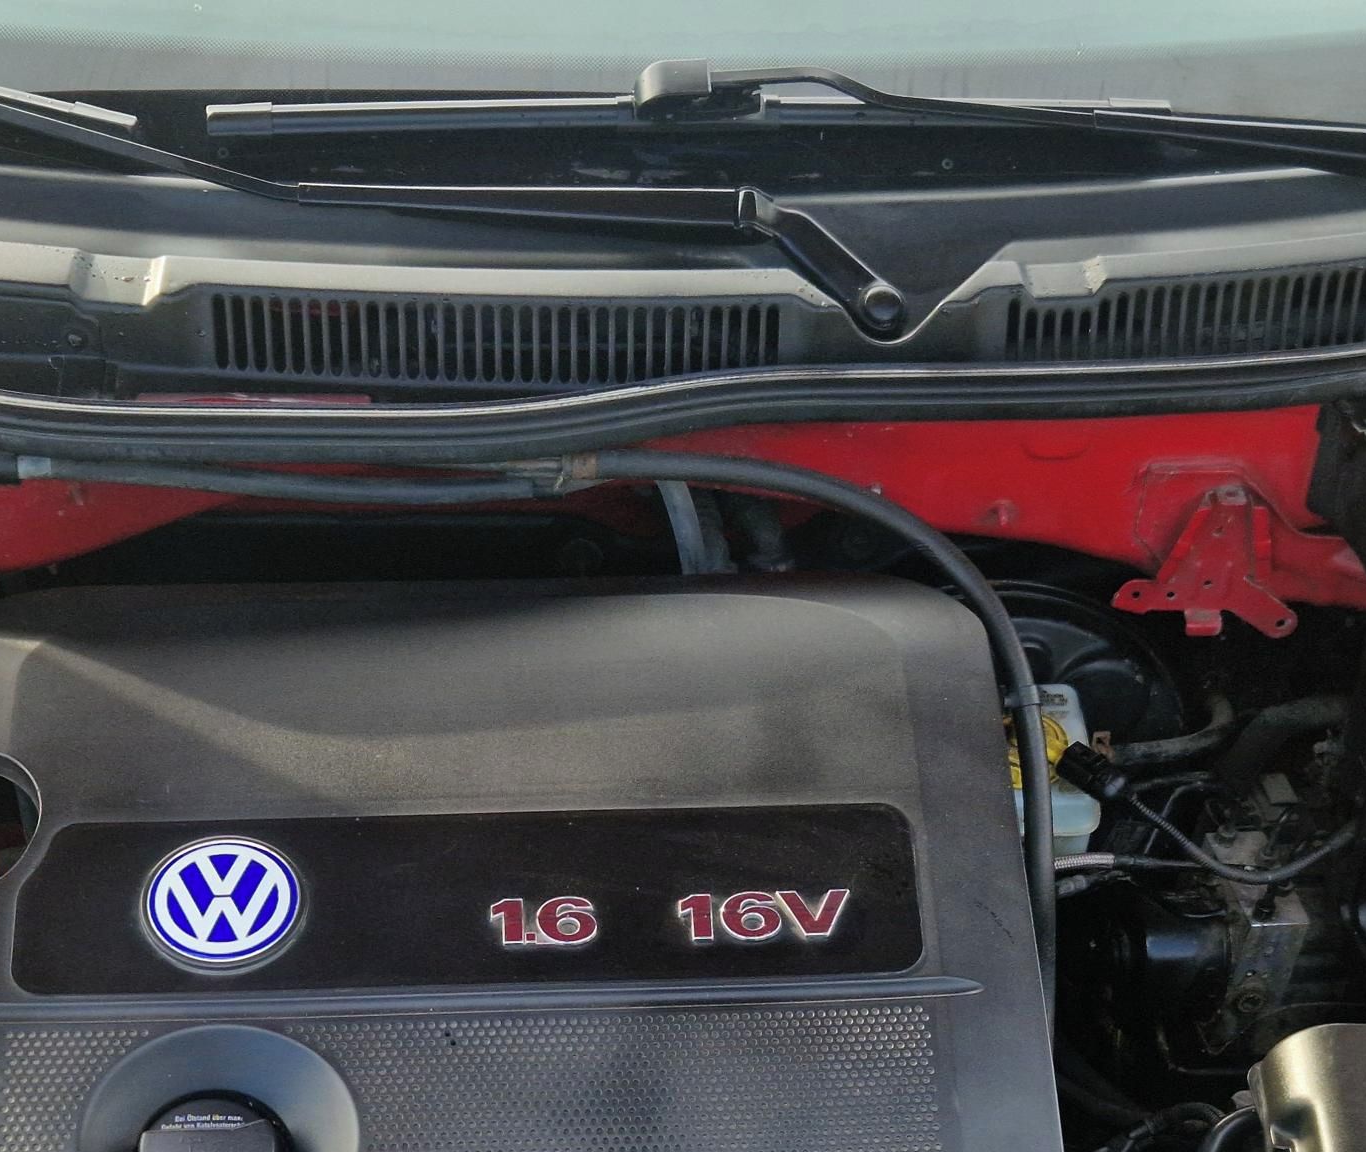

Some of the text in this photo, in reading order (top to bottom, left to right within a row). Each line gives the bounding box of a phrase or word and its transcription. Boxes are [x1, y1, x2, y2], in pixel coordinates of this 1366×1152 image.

[155, 844, 291, 955] VW
[490, 889, 850, 945] 1.6 16V
